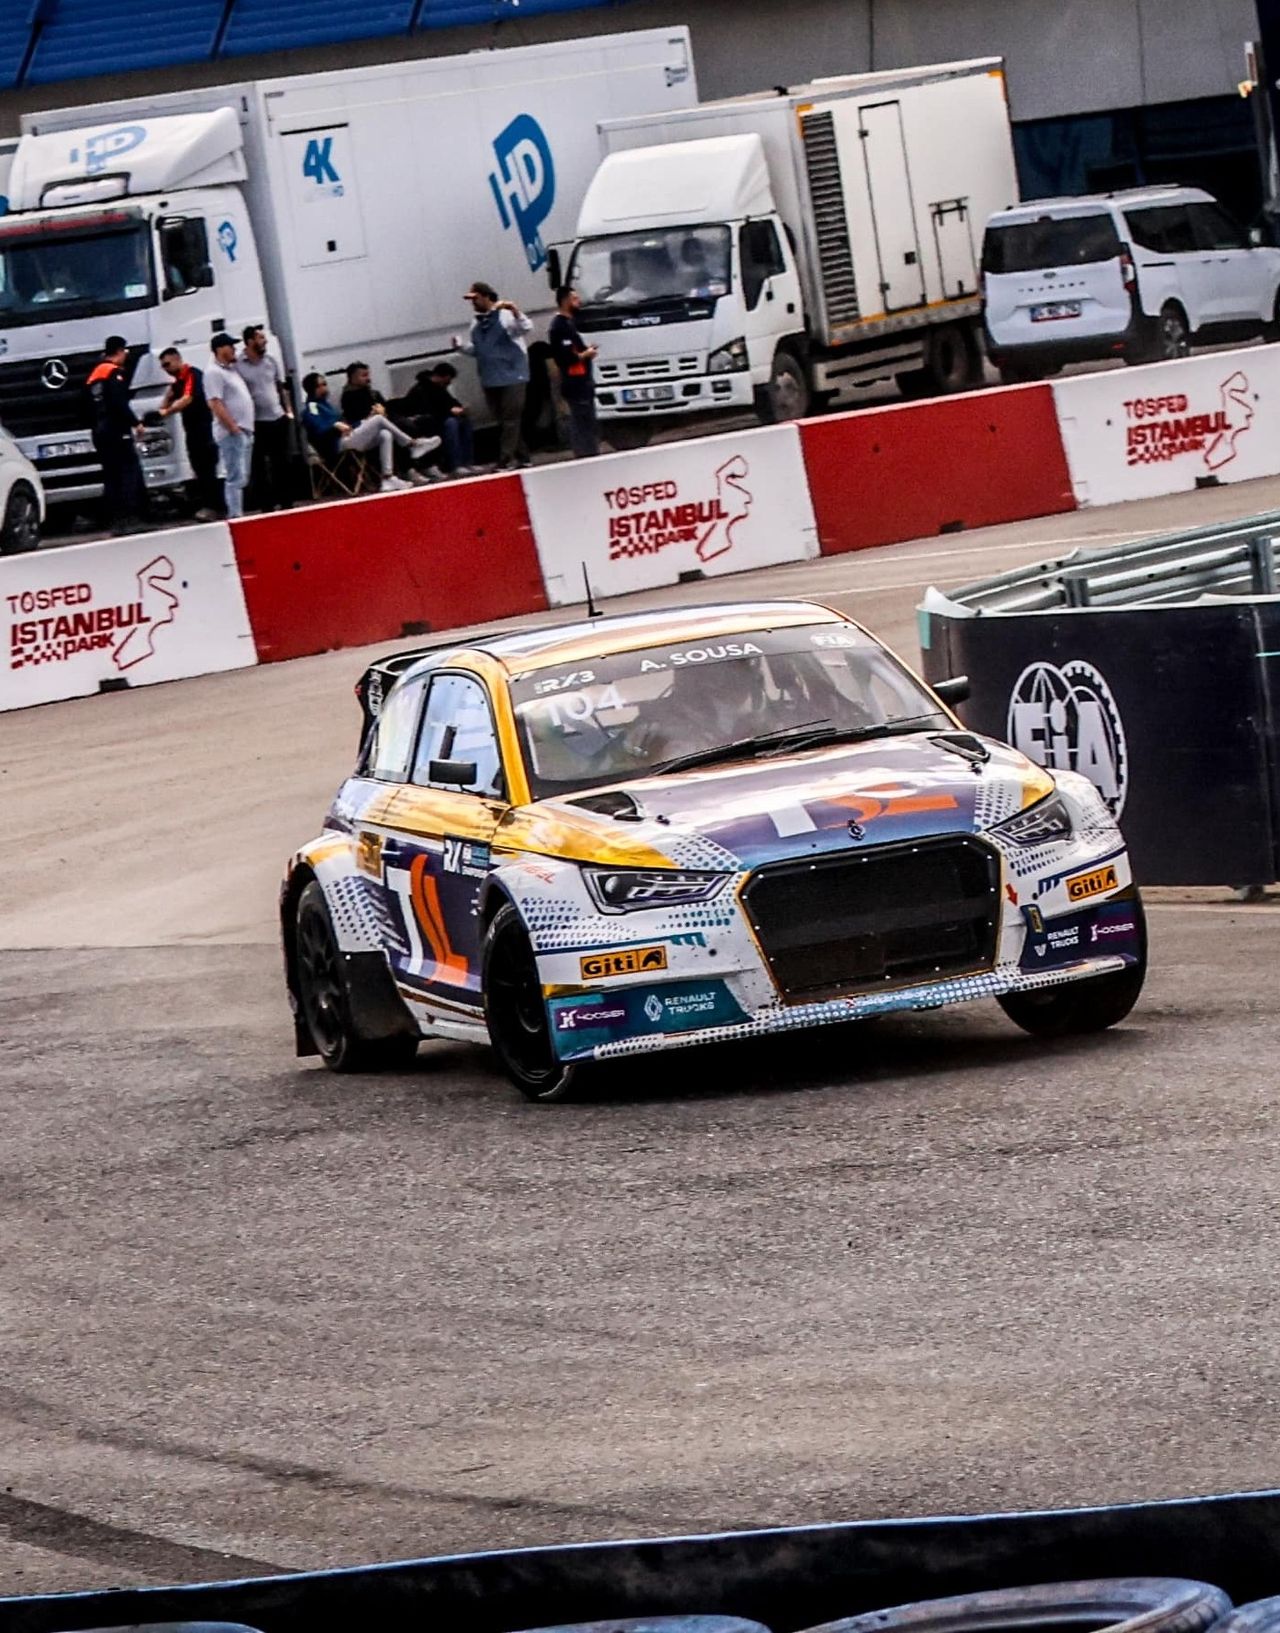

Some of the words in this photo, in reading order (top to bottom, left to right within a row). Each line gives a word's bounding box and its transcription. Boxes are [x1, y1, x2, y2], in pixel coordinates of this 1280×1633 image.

[303, 137, 341, 184] 4K
[1123, 394, 1188, 418] TOSFED
[1127, 411, 1232, 446] ISTANBUL
[604, 481, 677, 509] TOSFED
[609, 499, 729, 539] ISTANBUL
[655, 526, 699, 552] PARK
[6, 583, 92, 615] TOSFED
[11, 602, 151, 646] ISTANBUL
[63, 632, 115, 660] PARK
[640, 658, 666, 672] A.
[669, 643, 764, 666] SOUSA
[542, 670, 597, 693] RX3
[549, 685, 626, 726] 104
[1013, 699, 1121, 799] FIA
[1070, 875, 1102, 897] Giti
[1047, 926, 1079, 941] RENAULT
[1050, 936, 1079, 949] TRUCKS
[584, 955, 634, 977] Giti
[664, 992, 717, 1006] RENAULT
[668, 1001, 715, 1015] TRUCKS
